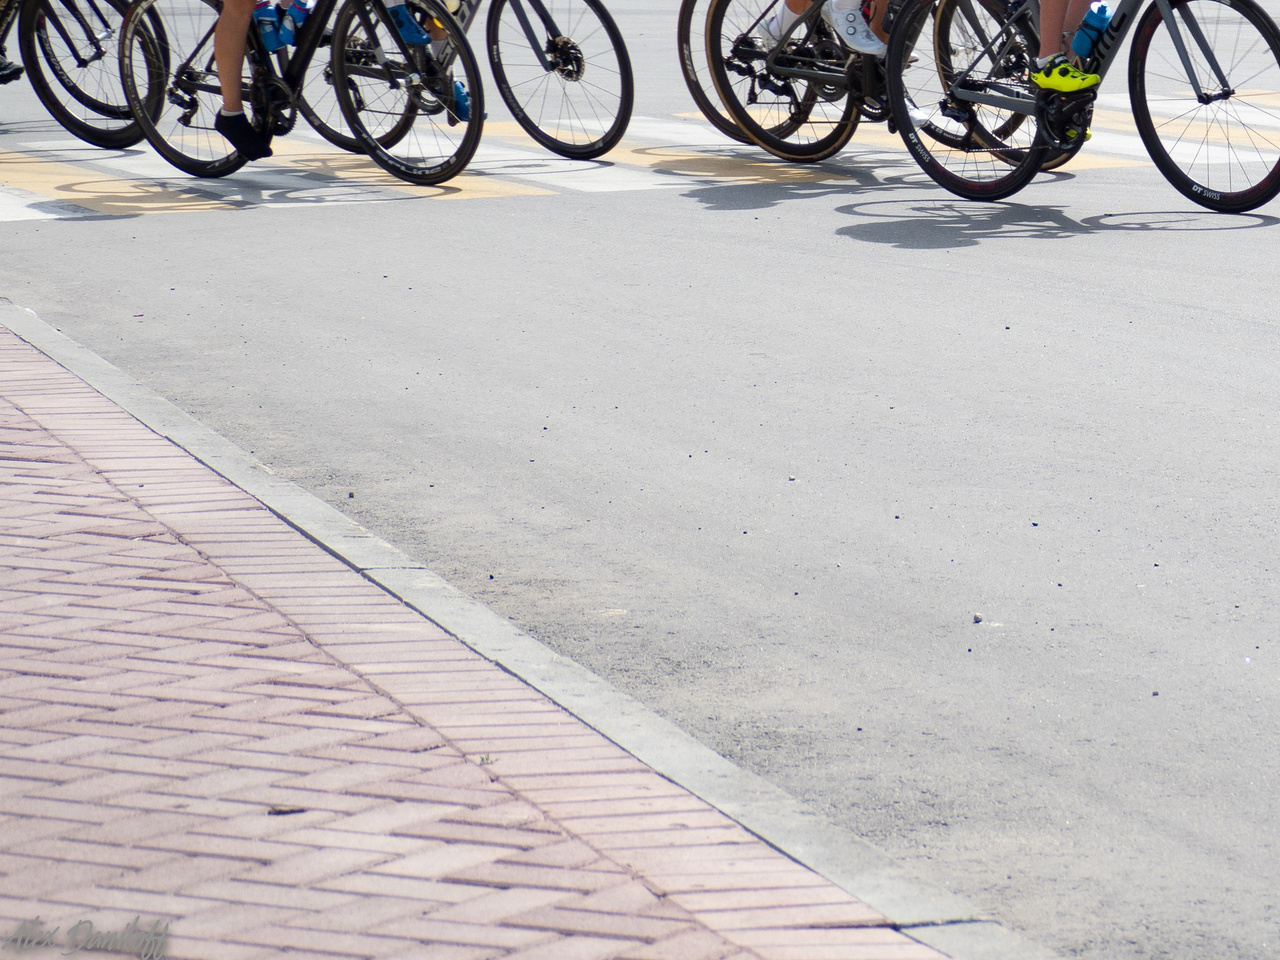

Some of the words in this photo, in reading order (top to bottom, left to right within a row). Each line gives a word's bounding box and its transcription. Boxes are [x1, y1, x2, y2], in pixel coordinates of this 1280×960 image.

[908, 132, 919, 145] DT
[916, 145, 931, 163] SWISS
[1192, 184, 1204, 194] DT
[1203, 189, 1221, 201] SWISS
